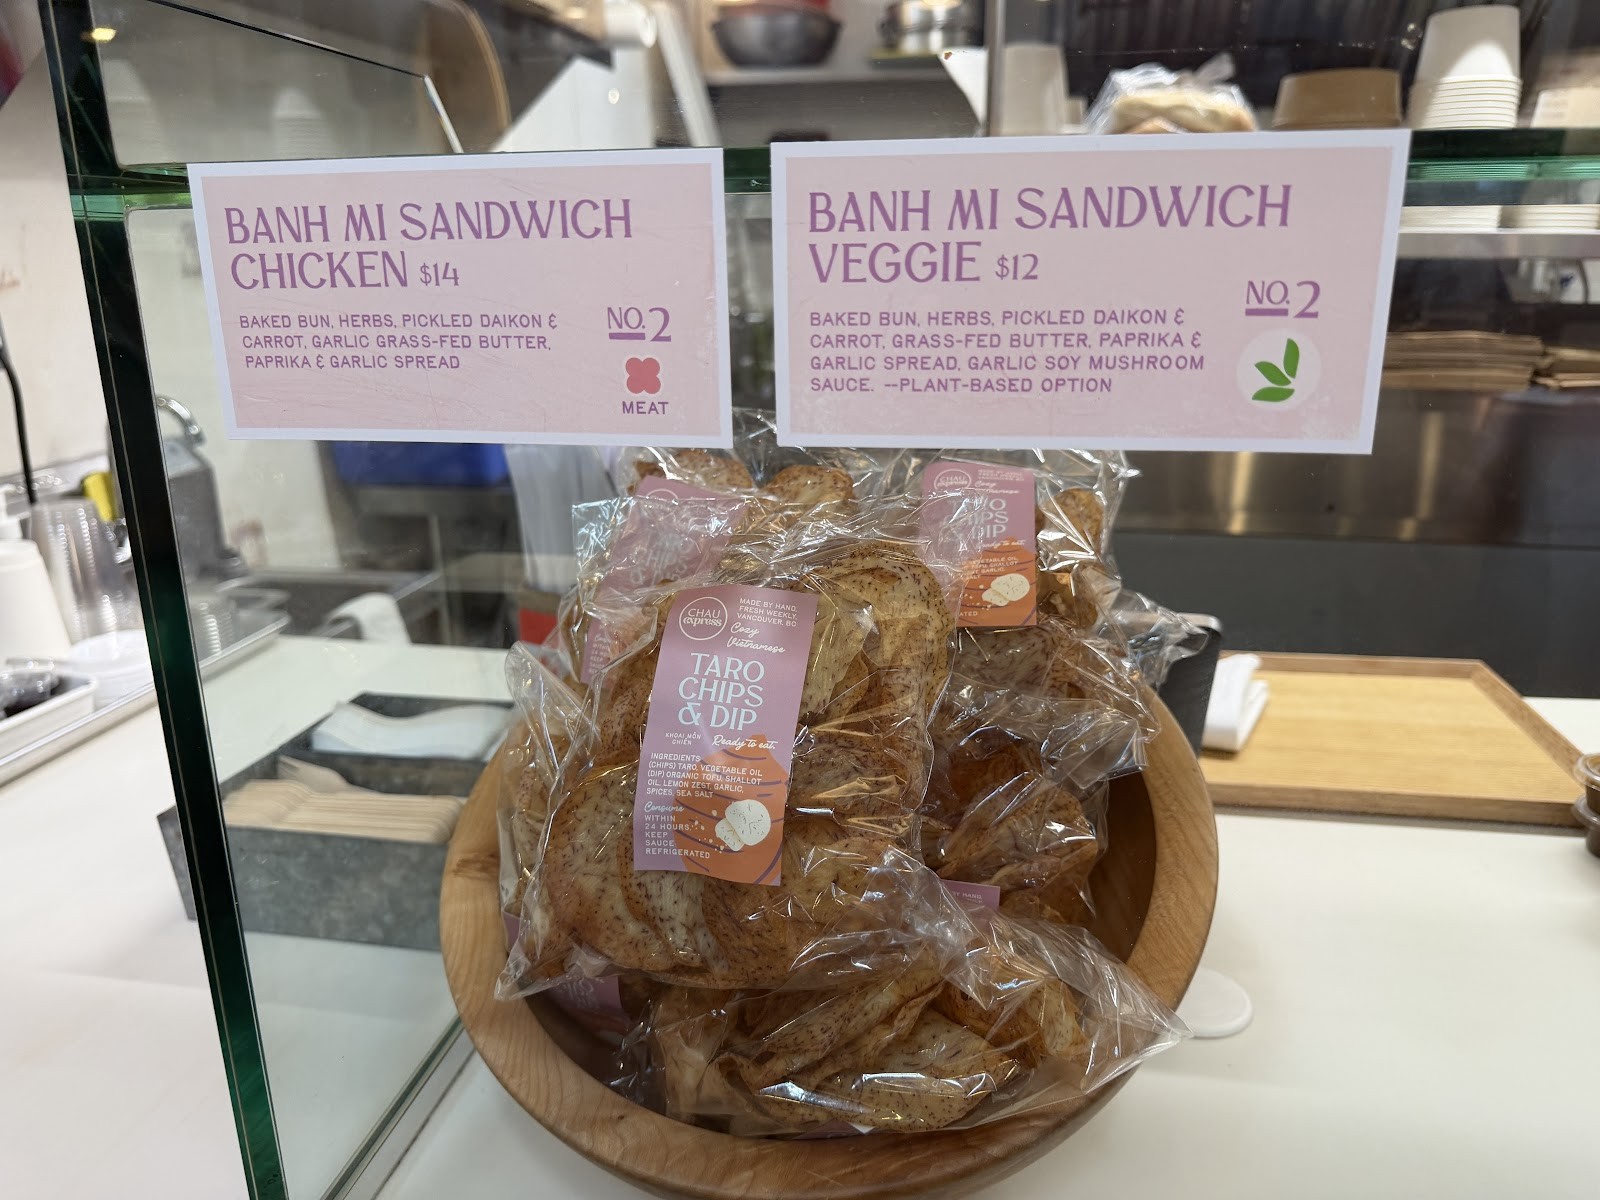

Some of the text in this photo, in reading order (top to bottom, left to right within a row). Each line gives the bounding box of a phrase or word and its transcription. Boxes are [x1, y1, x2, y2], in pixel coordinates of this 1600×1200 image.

[808, 184, 1293, 233] BANH MI SANDWICH
[225, 198, 633, 245] BANH MI SANDWICH
[230, 250, 460, 290] CHICKEN $14
[809, 241, 1040, 284] VEGGIE $12
[239, 313, 558, 330] BAKED BUN, HERBS, PICKLED DAIKON &
[810, 308, 1185, 328] BAKED BUN, HERBS, PICKLED DAIKON &
[242, 334, 552, 350] CARROT, GARLIC GRASS-FED BUTTER,
[810, 331, 1202, 351] CARROT, GRASS-FED BUTTER, PAPRIKA &
[245, 354, 460, 370] PAPRIKA & GARLIC SPREAD
[810, 355, 1206, 373] GARLIC SPREAD, GARLIC SOY MUSHROOM
[810, 377, 874, 393] SAUCE.
[1041, 377, 1113, 393] OPTION
[622, 401, 669, 415] MEAT
[739, 598, 761, 607] MADE
[763, 600, 773, 608] BY
[739, 605, 765, 615] FRESH
[688, 607, 721, 619] CHAU
[683, 616, 723, 628] express
[730, 622, 760, 638] Cozy
[727, 636, 786, 654] Vietnamese
[690, 652, 765, 683] TARO
[678, 676, 764, 708] CHIPS
[678, 702, 758, 731] & DIP
[665, 732, 685, 740] KHOAI
[711, 735, 747, 751] Ready
[746, 739, 757, 748] to
[648, 760, 677, 770] (CHIPS)
[700, 764, 747, 775] VEGETABLE
[749, 768, 763, 777] OIL
[647, 769, 665, 778] (DIP)
[665, 771, 700, 780] ORGANIC
[725, 775, 762, 786] SHALLOT
[663, 780, 690, 788] LEMON
[675, 789, 693, 797] SEA
[694, 790, 714, 799] SALT
[644, 800, 685, 813] Consume
[644, 814, 676, 822] WITHIN
[645, 839, 675, 847] SAUCE
[645, 847, 711, 859] REFRIGERATED
